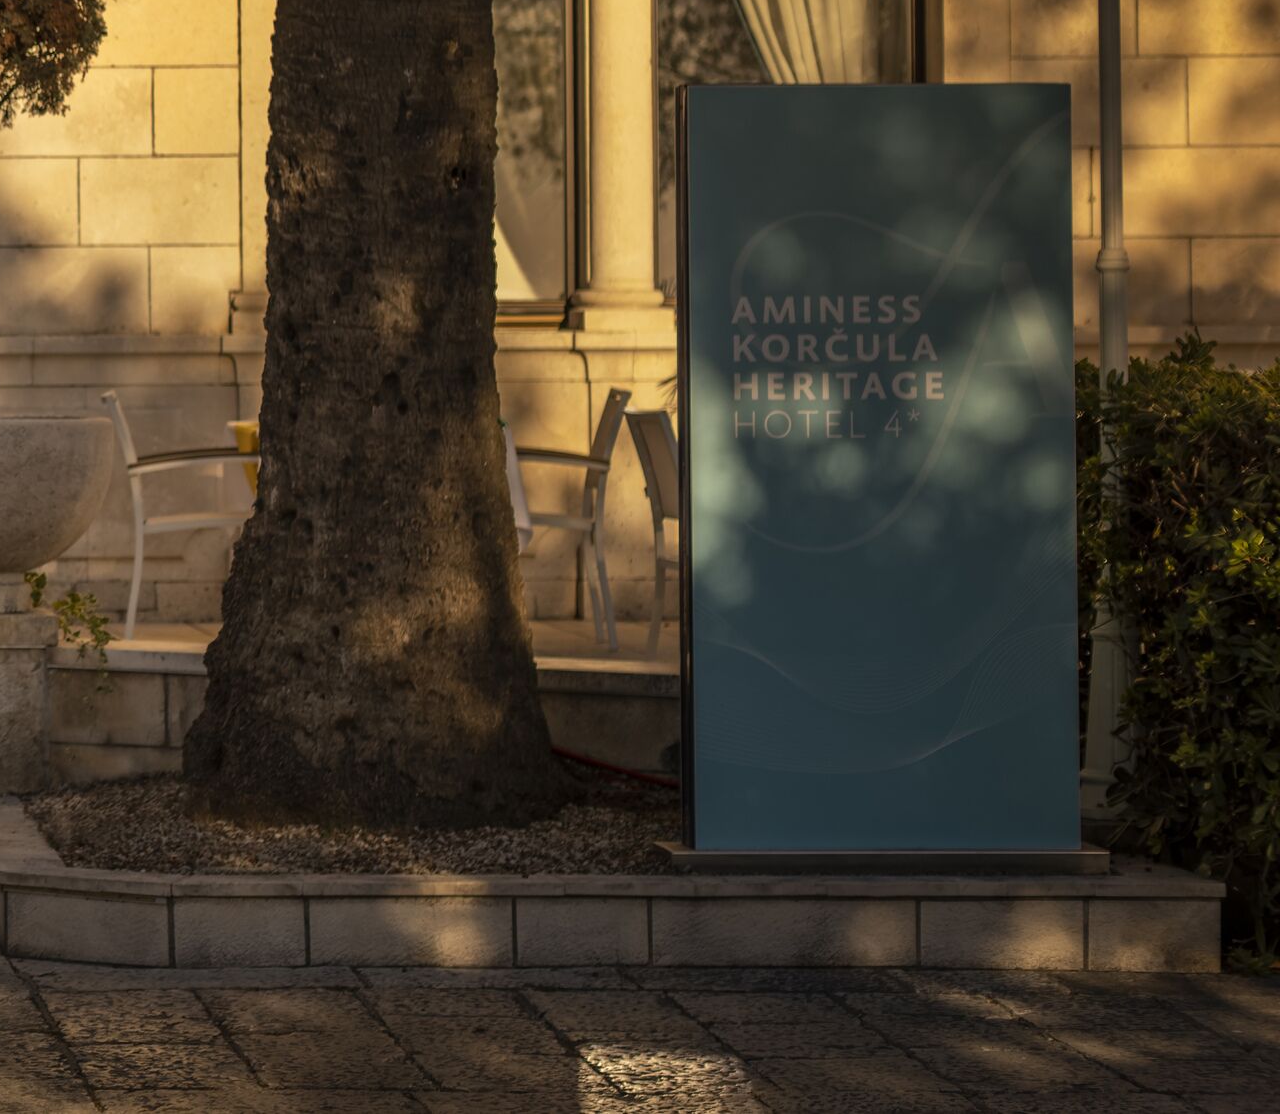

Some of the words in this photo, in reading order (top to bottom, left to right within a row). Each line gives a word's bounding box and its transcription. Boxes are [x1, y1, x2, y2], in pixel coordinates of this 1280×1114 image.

[731, 294, 921, 324] AMINESS
[733, 328, 938, 362] KORČULA
[733, 371, 945, 401] HERITAGE
[734, 409, 866, 439] HOTEL
